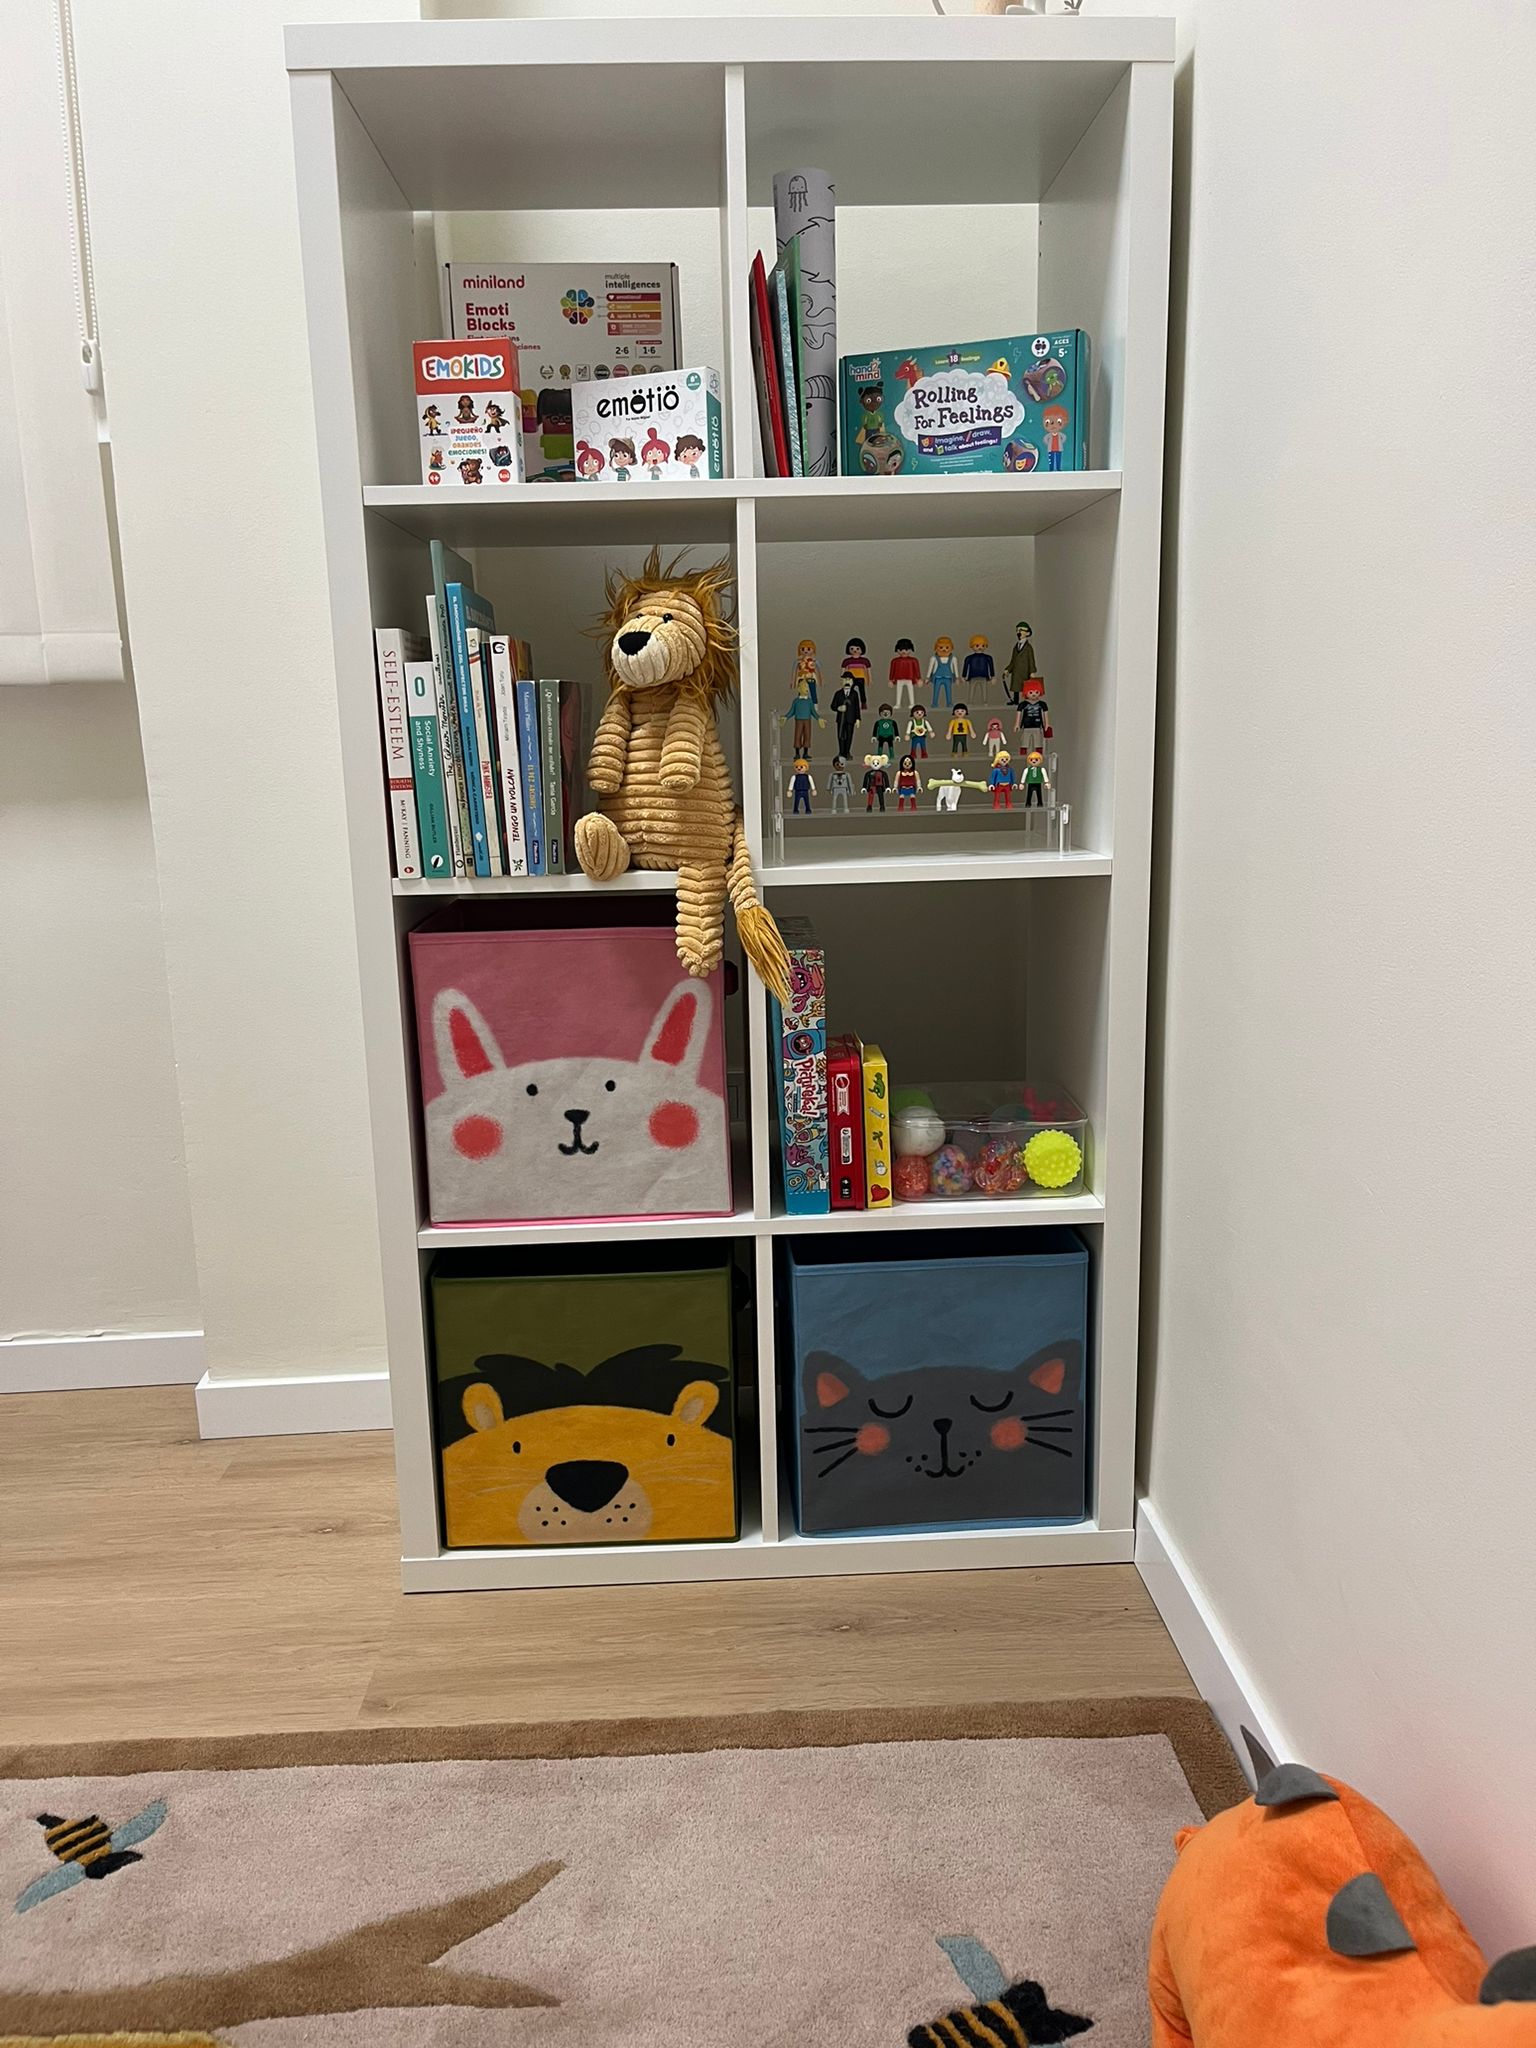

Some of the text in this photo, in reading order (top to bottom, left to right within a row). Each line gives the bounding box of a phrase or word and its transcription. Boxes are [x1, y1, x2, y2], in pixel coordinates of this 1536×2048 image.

[463, 274, 525, 289] miniland
[605, 273, 630, 281] multiple
[605, 280, 661, 290] intelligences
[465, 302, 509, 316] Emoti
[466, 318, 516, 331] Blocks
[950, 354, 959, 363] 18
[425, 356, 503, 379] EMOKIDS
[855, 371, 880, 381] mind
[912, 386, 978, 410] Rolling
[914, 404, 1014, 430] For Feelings
[944, 444, 958, 452] talk
[975, 438, 998, 447] feelings!
[383, 650, 404, 760] SELF-ESTEEM
[416, 737, 425, 770] Shyness
[424, 720, 436, 777] Social Anxiety
[446, 762, 455, 779] The
[510, 802, 518, 814] UN
[511, 815, 520, 843] TENGO
[402, 827, 412, 860] FANNING
[794, 1057, 818, 1117] Pictureka!
